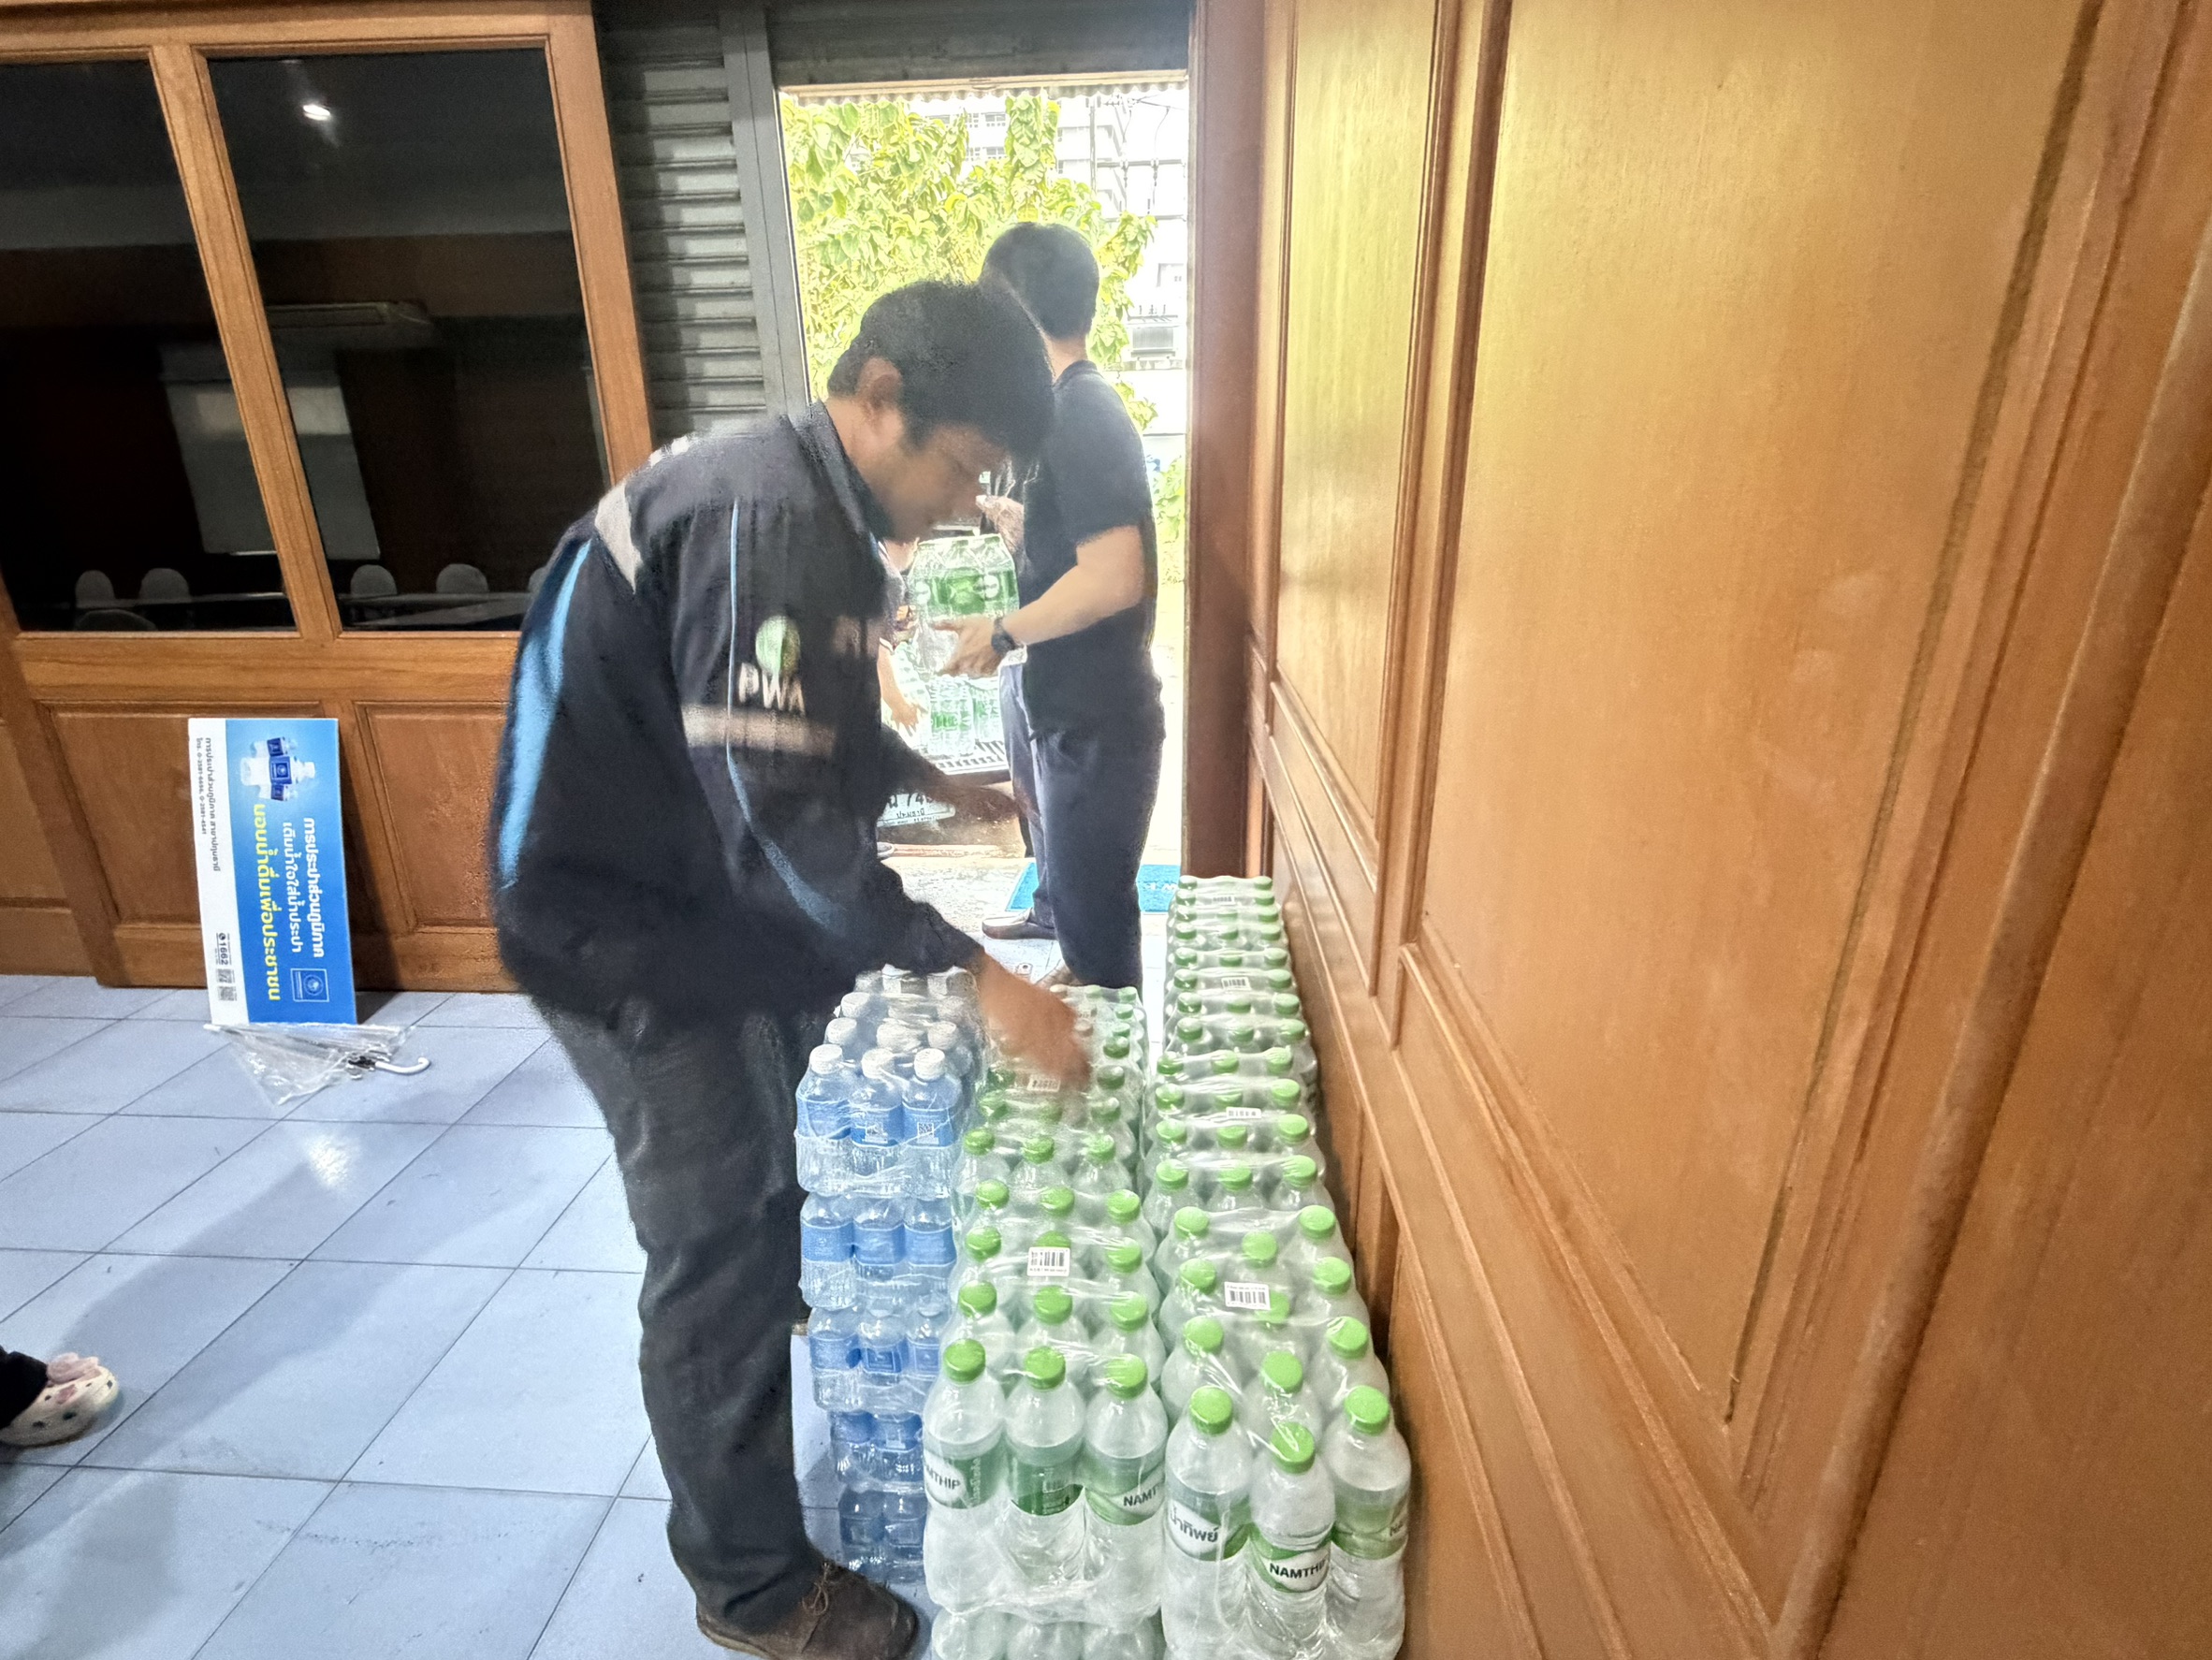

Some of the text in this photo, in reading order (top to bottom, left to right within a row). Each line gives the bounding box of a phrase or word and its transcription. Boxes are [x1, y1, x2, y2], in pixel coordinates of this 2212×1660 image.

[303, 817, 325, 958] การประปาส่วนภูมิภาค
[219, 941, 228, 966] 1662
